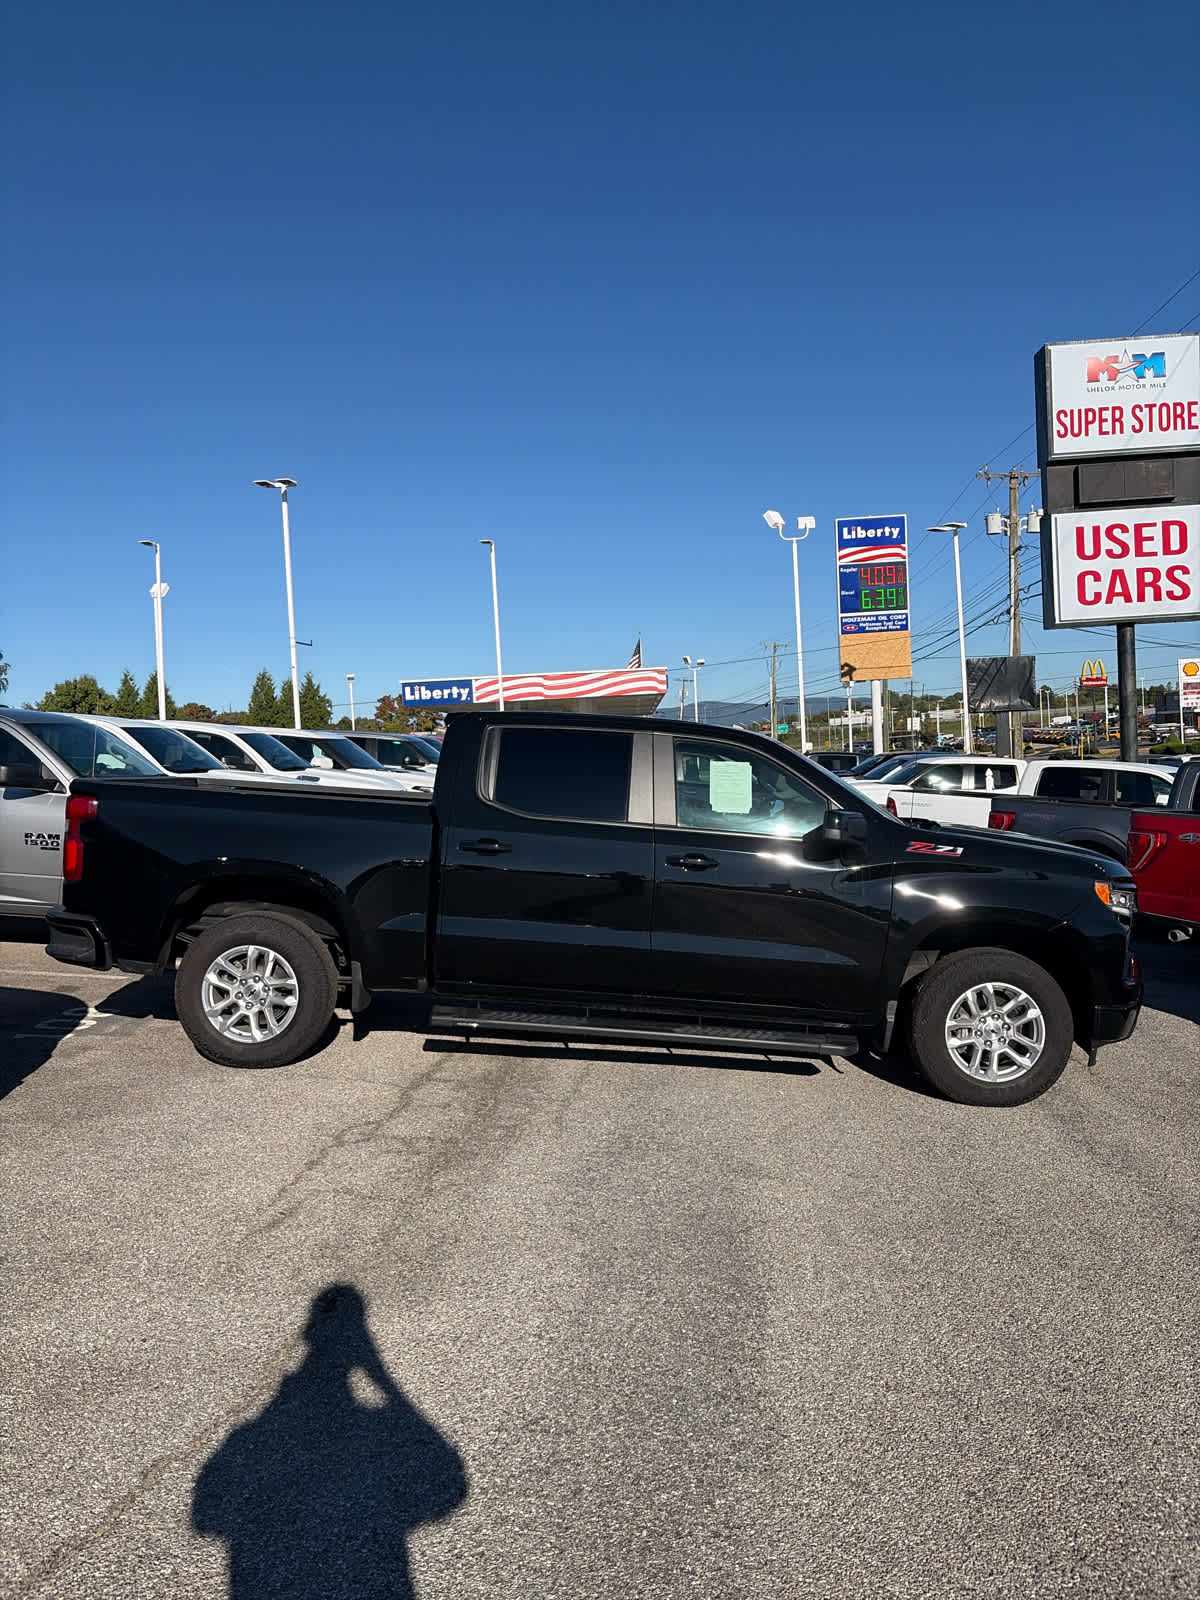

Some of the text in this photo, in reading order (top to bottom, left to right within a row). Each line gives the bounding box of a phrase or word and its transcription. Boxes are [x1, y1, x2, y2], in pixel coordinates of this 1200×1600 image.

[1087, 385, 1115, 393] SHELOR
[1118, 383, 1147, 391] MOTOR
[1056, 401, 1200, 438] SUPER STORE
[843, 526, 901, 539] Liberty
[1075, 520, 1189, 561] USED
[1077, 565, 1191, 606] CARS
[862, 588, 897, 609] 6.39
[404, 685, 470, 701] Liberty
[24, 832, 60, 840] RAM
[906, 841, 964, 856] Z71
